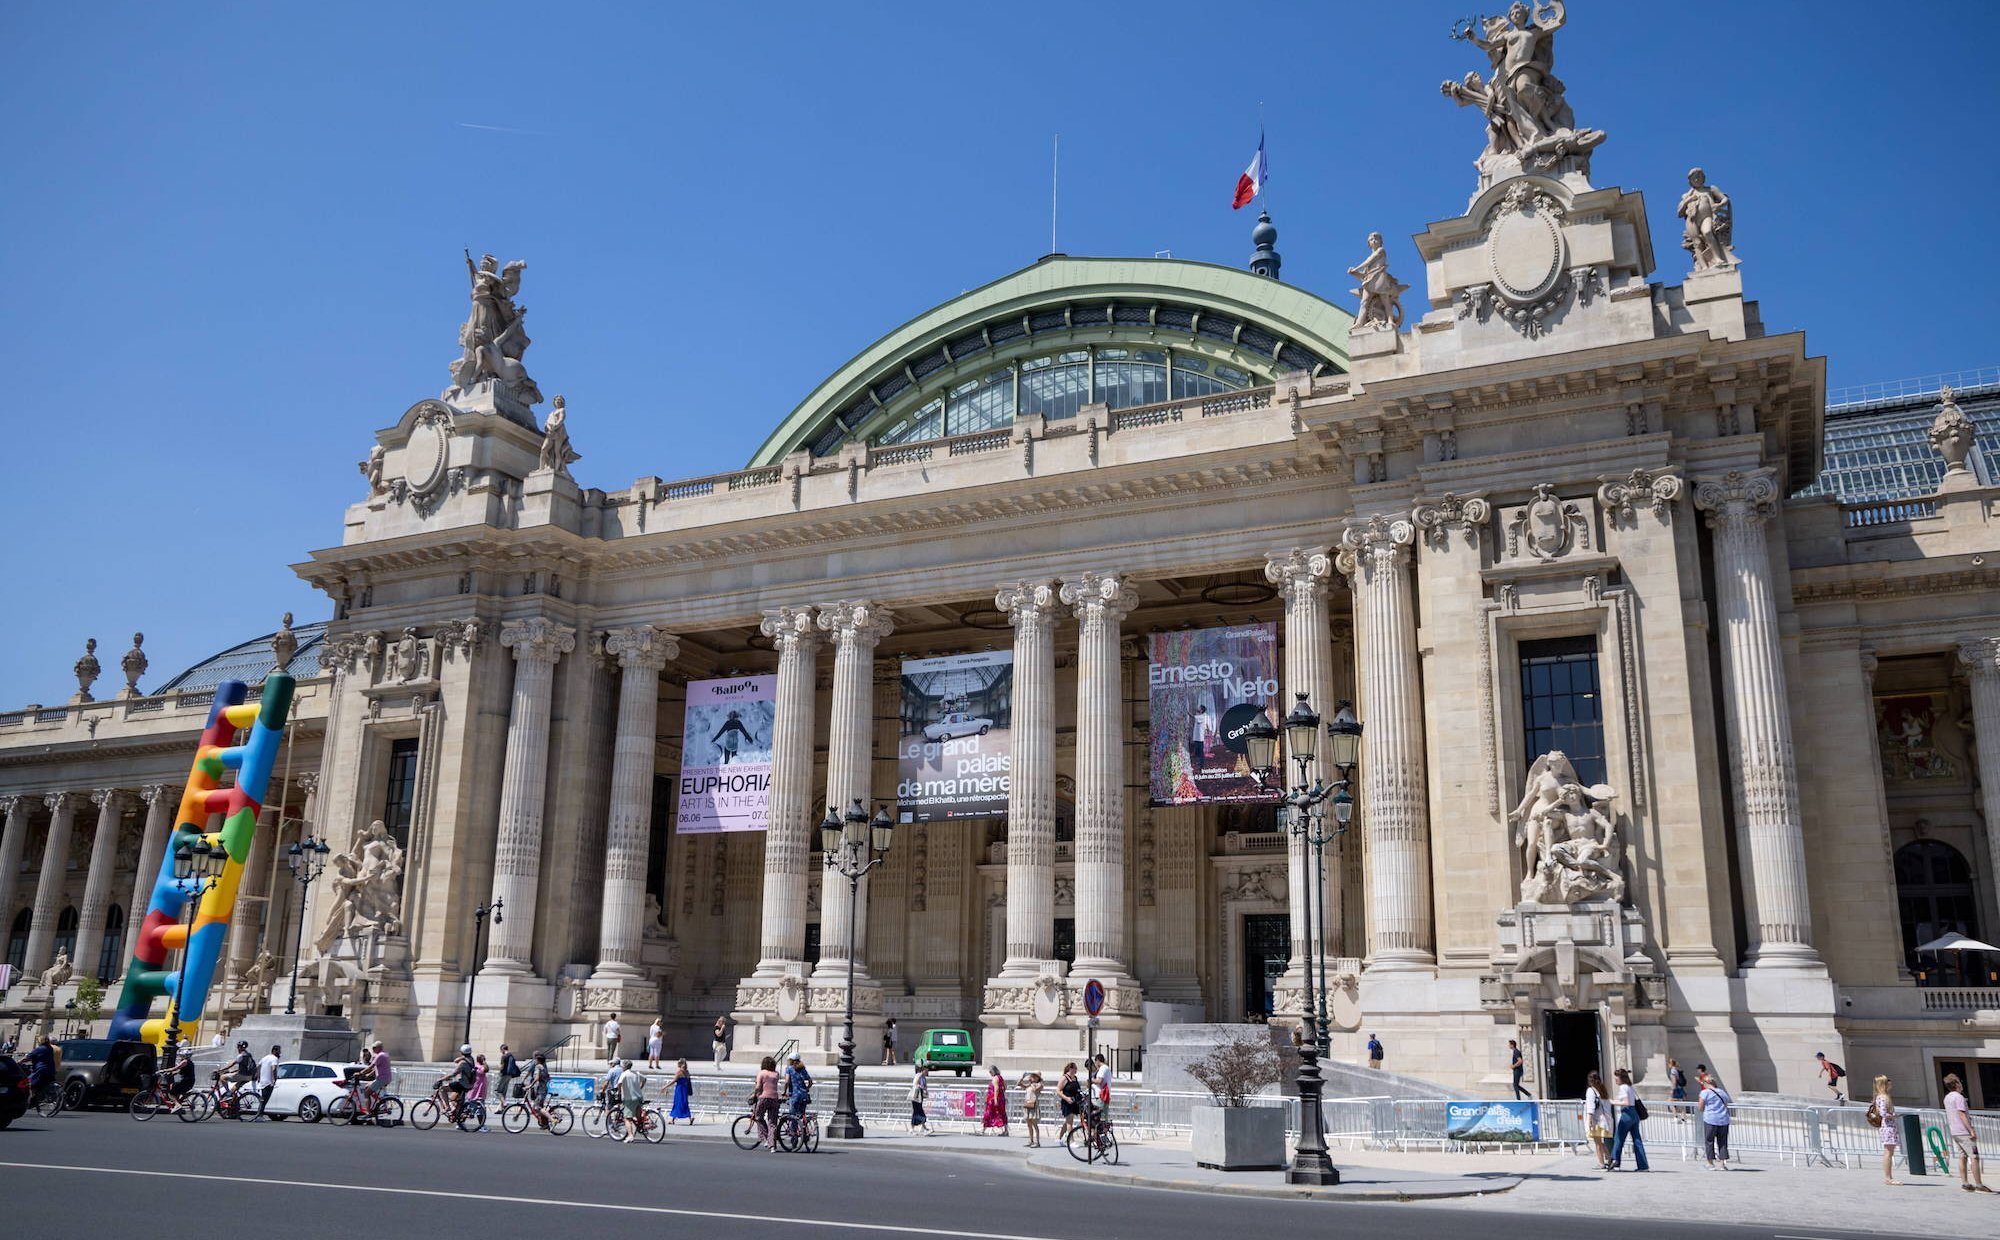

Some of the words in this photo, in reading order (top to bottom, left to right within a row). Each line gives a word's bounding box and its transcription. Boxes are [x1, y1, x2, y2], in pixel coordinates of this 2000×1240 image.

[1148, 659, 1233, 684] Ernesto
[711, 681, 759, 695] Balloon
[1223, 675, 1279, 699] Neto
[898, 740, 921, 760] Le
[923, 733, 980, 761] grand
[715, 766, 728, 774] THE
[728, 765, 743, 773] NEW
[743, 764, 771, 772] EXHIBITI
[956, 752, 1011, 779] palais
[896, 778, 923, 798] de
[924, 779, 957, 797] ma
[959, 772, 1010, 794] mère
[680, 797, 703, 809] ART
[704, 796, 715, 809] IS
[718, 796, 729, 808] IN
[732, 795, 754, 807] THE
[756, 795, 770, 806] AI
[896, 797, 929, 807] Mohamed
[969, 792, 1009, 802] rétrospectiv
[678, 813, 702, 823] 06.06
[751, 810, 769, 820] 07.0
[928, 1092, 964, 1100] andPalais
